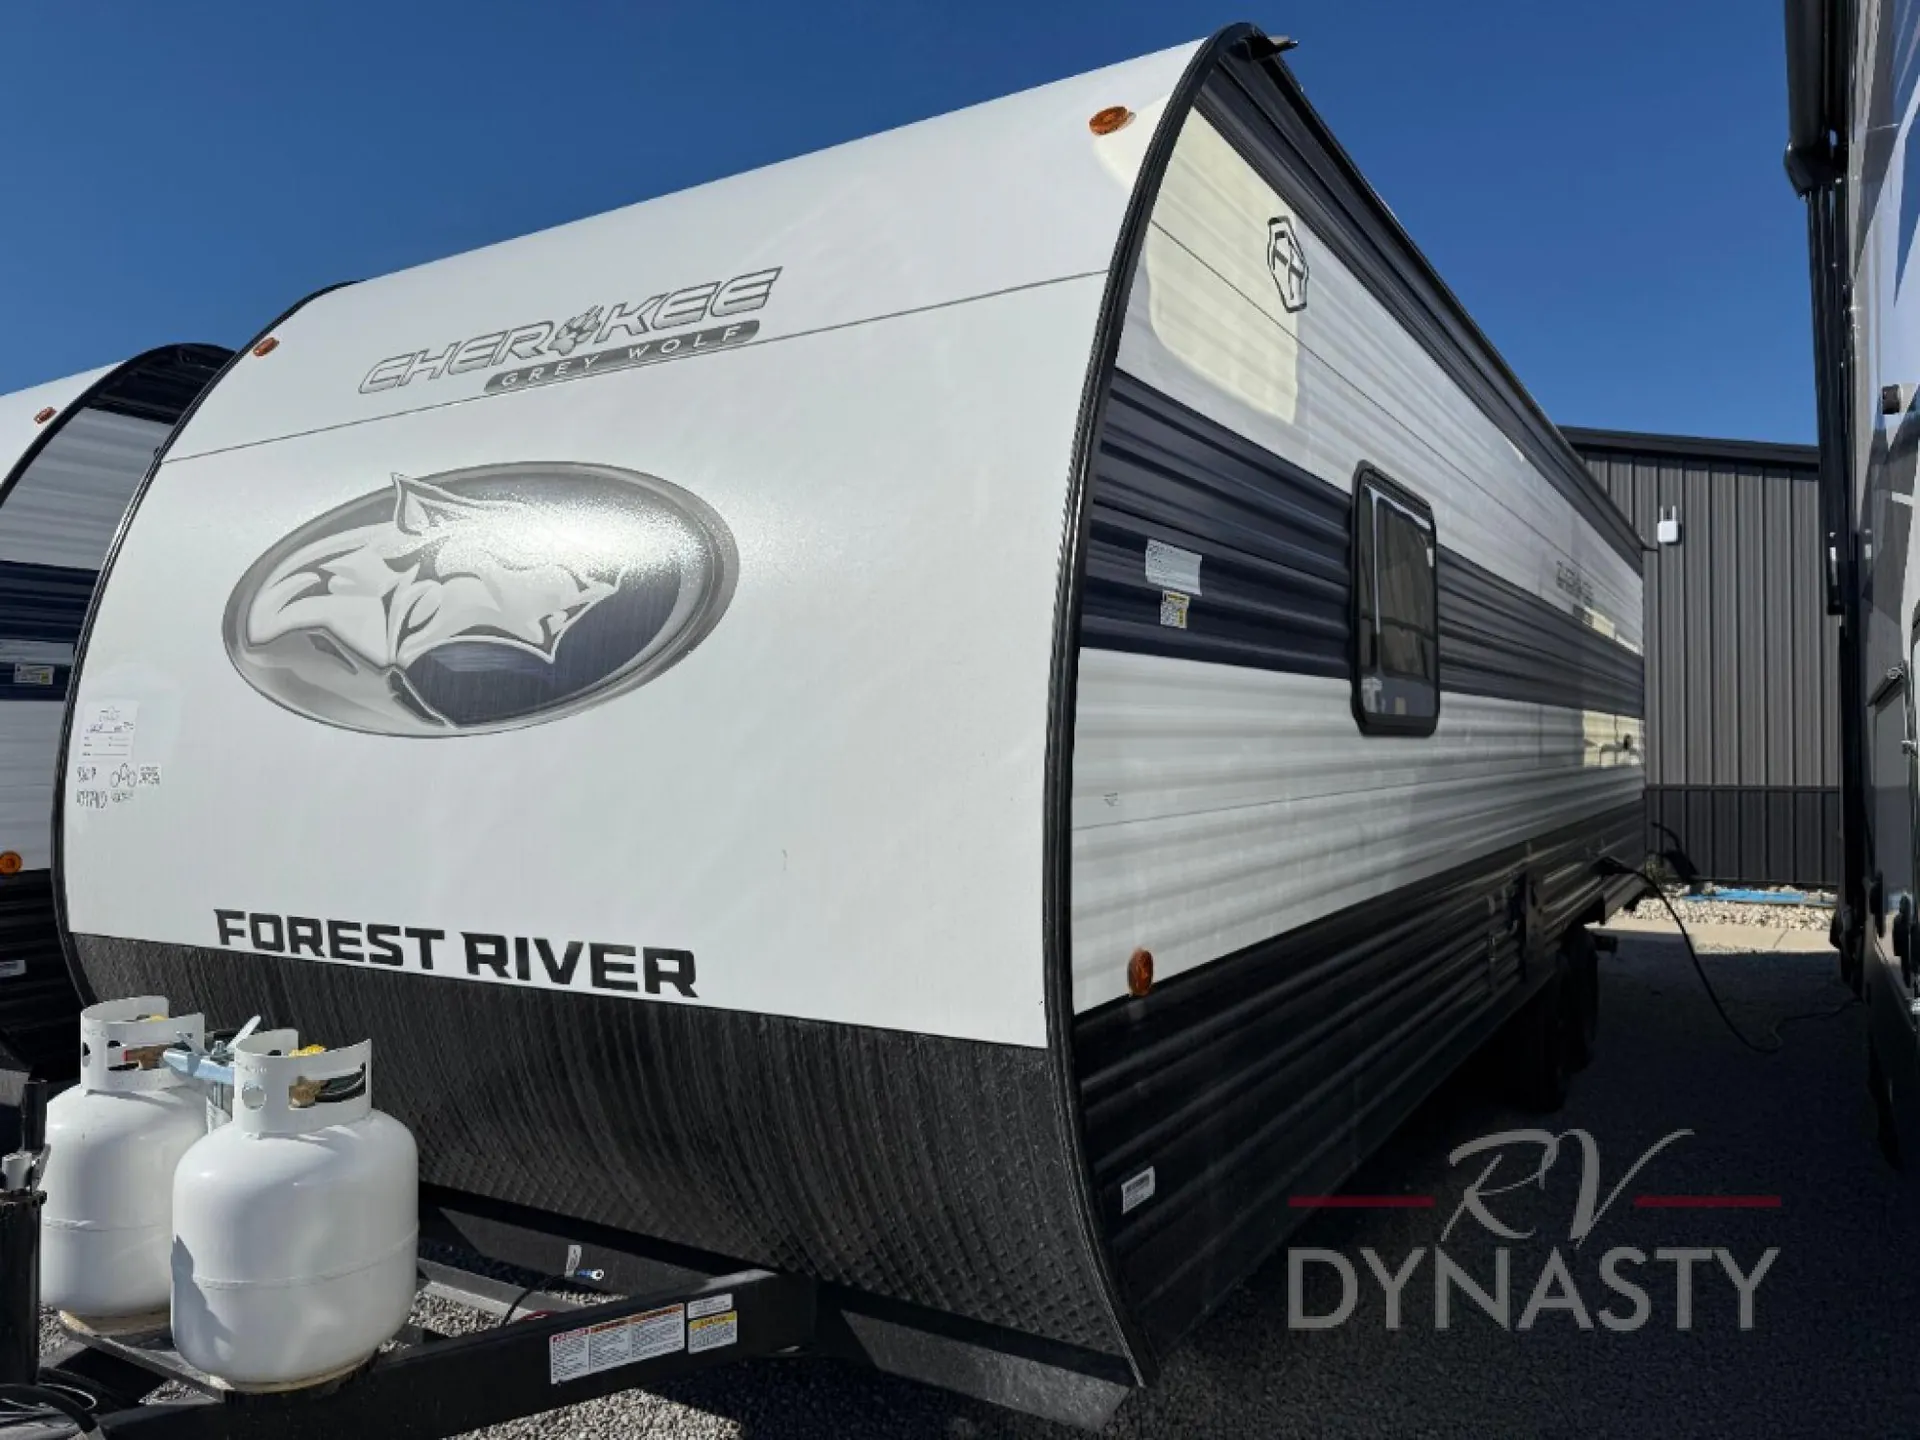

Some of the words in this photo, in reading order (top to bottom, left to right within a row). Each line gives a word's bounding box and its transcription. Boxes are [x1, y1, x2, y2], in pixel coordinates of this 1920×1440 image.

[500, 353, 600, 388] GREY
[627, 323, 743, 361] WOLF
[213, 908, 446, 971] FOREST
[458, 930, 700, 998] RIVER
